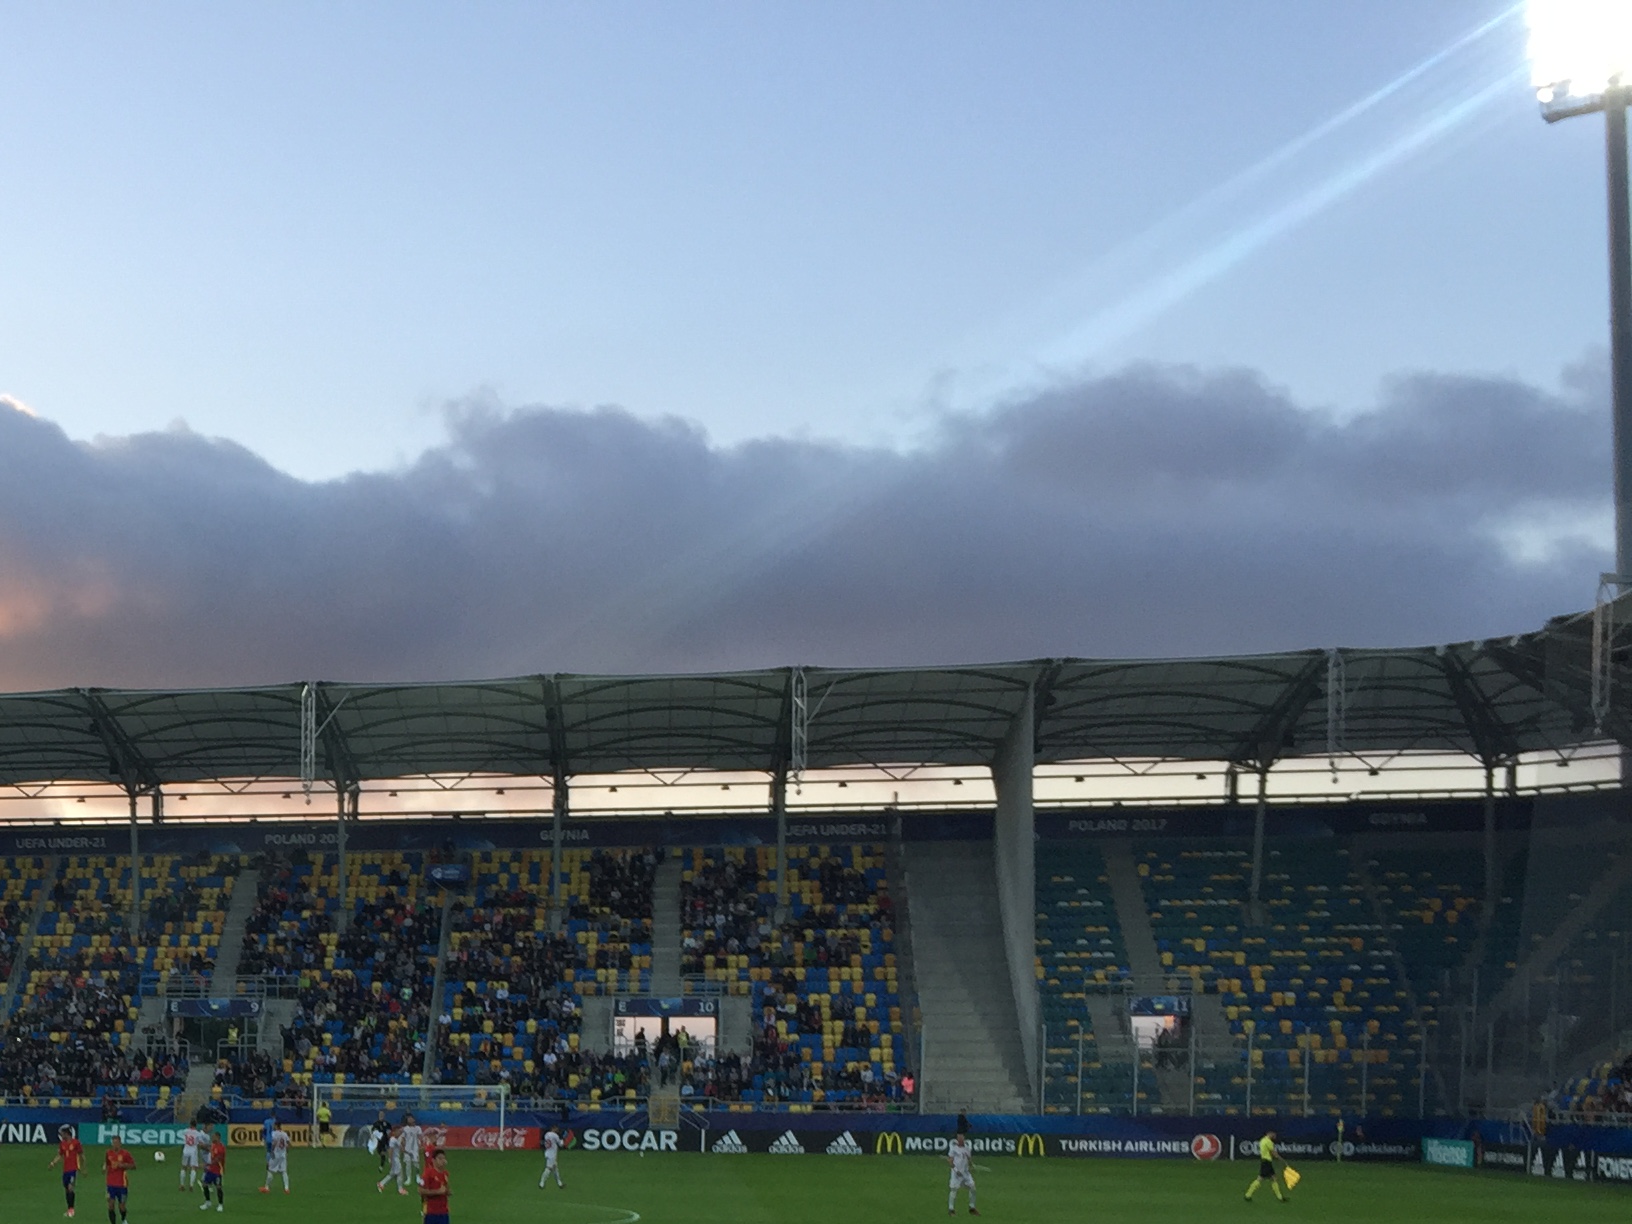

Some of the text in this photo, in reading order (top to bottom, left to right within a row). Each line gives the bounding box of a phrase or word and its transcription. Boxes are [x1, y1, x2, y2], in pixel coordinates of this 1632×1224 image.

[16, 836, 106, 849] UEFA UNDER-21
[264, 833, 349, 845] POLAND 207
[250, 1001, 259, 1013] 9
[699, 1001, 714, 1013] 10
[98, 1124, 188, 1145] Hisens
[582, 1128, 678, 1151] SOCAR
[1059, 1139, 1189, 1153] TURKISH AIRLINES
